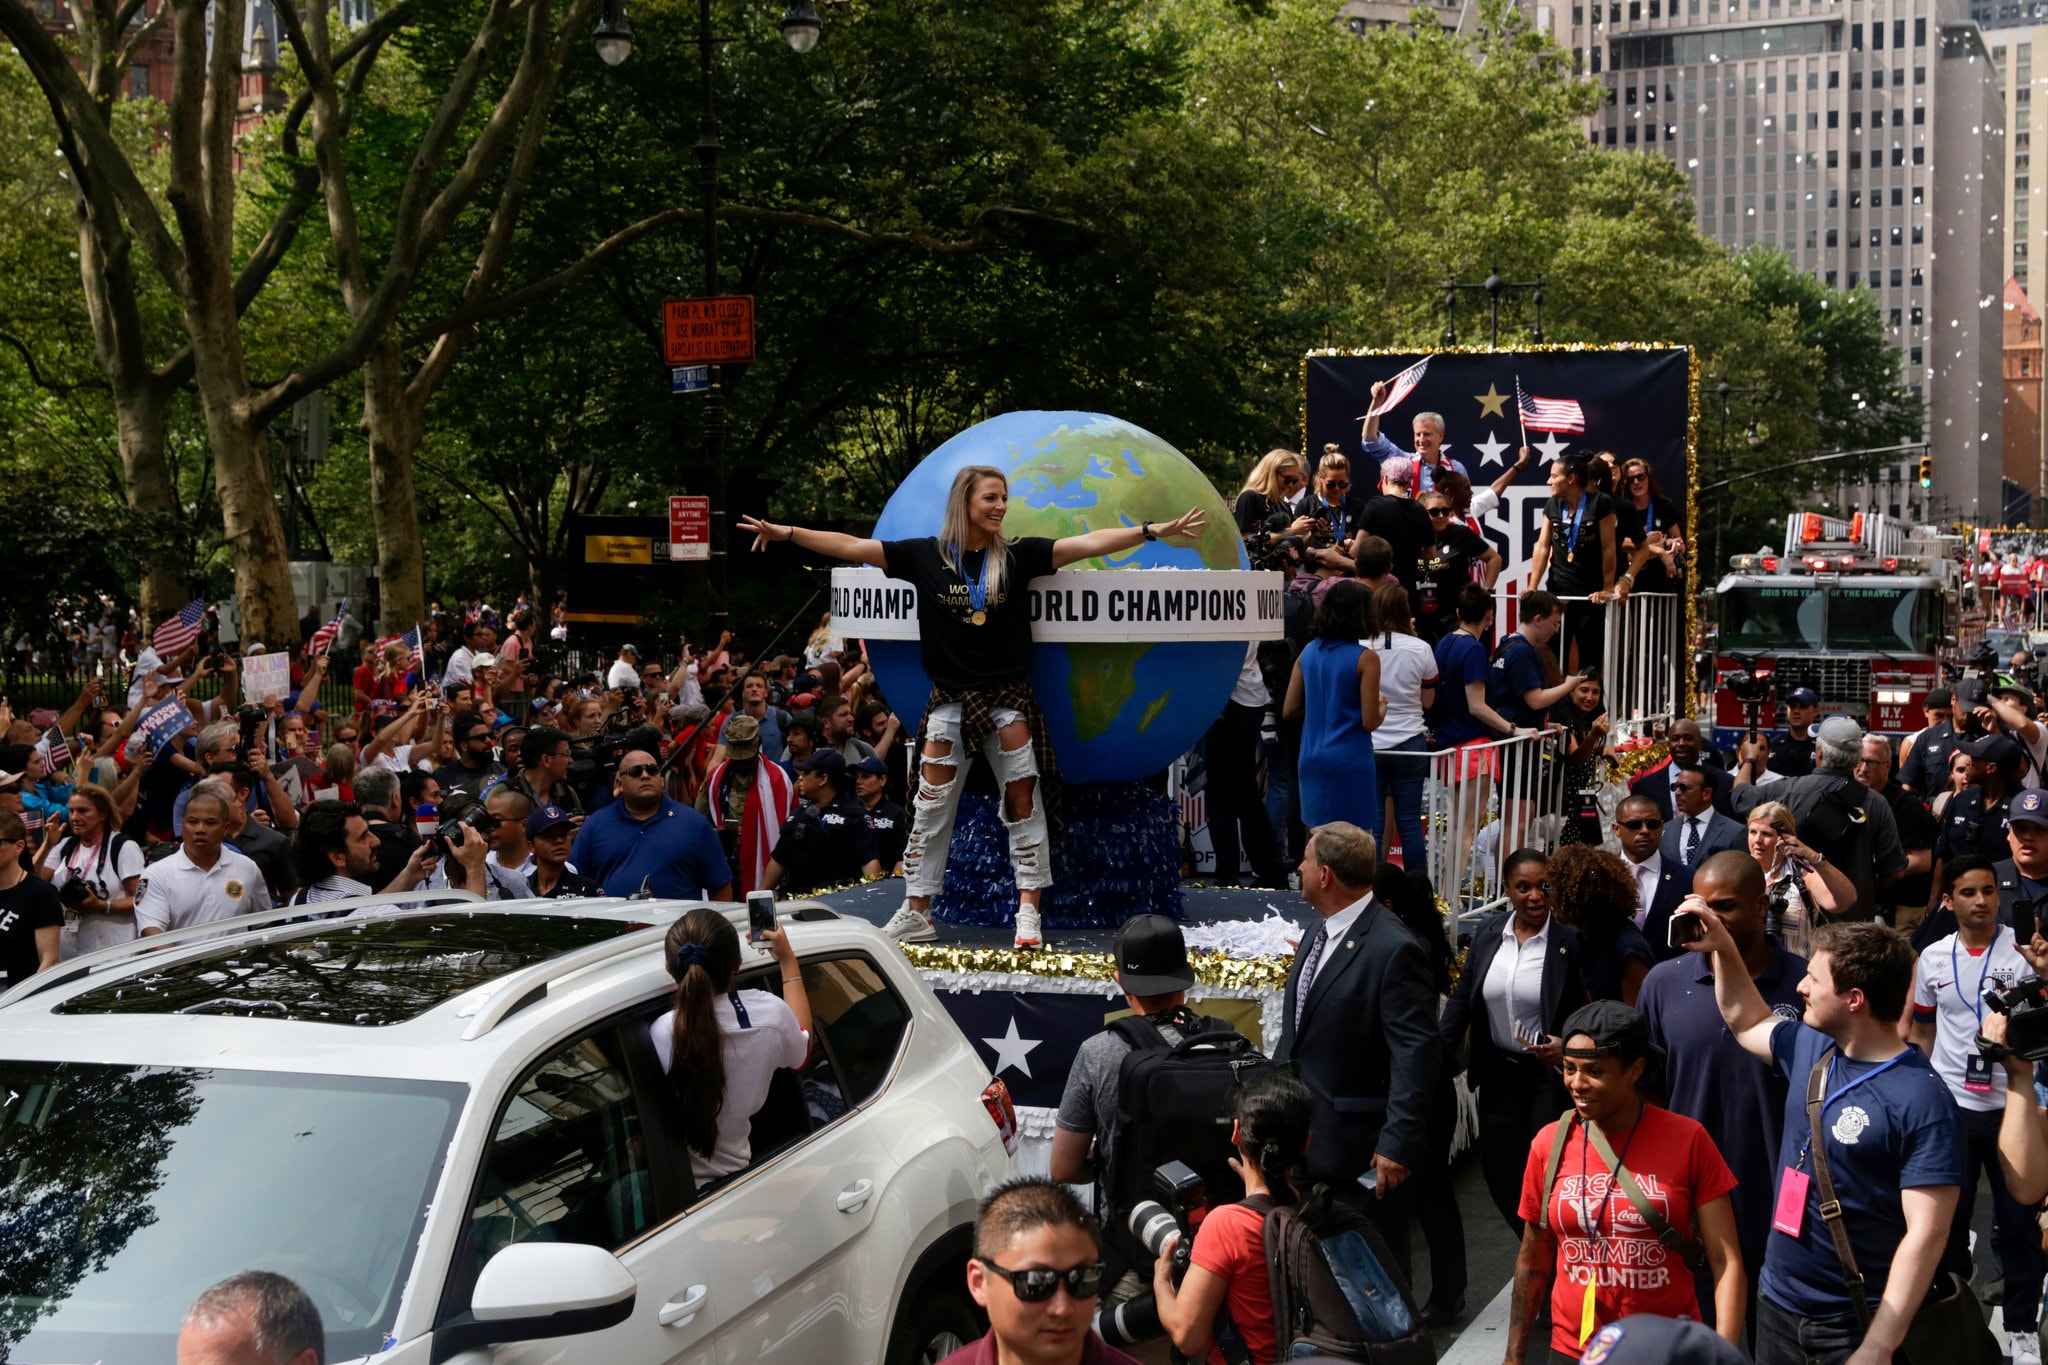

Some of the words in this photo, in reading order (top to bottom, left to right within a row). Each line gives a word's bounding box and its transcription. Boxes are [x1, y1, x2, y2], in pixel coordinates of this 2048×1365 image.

[672, 305, 689, 320] PARK
[692, 305, 701, 319] PL
[719, 303, 744, 318] CLOSED
[675, 323, 689, 338] USE
[691, 321, 718, 337] MURRAY
[721, 321, 730, 336] ST
[671, 342, 694, 357] BARCLAY
[696, 341, 703, 355] ST
[705, 341, 712, 355] AS
[832, 587, 850, 617] RLD
[853, 588, 915, 619] CHAMP
[1781, 589, 1799, 597] THE
[1844, 589, 1861, 598] THE
[1862, 590, 1901, 598] BRAVEST
[1028, 590, 1099, 622] ORLD
[1108, 589, 1246, 622] CHAMPIONS
[1257, 589, 1284, 620] WORL
[141, 702, 178, 728] NATION
[1880, 706, 1904, 718] N.Y.
[1560, 1173, 1667, 1197] SPECAL
[1564, 1264, 1671, 1290] VOLUNTEER
